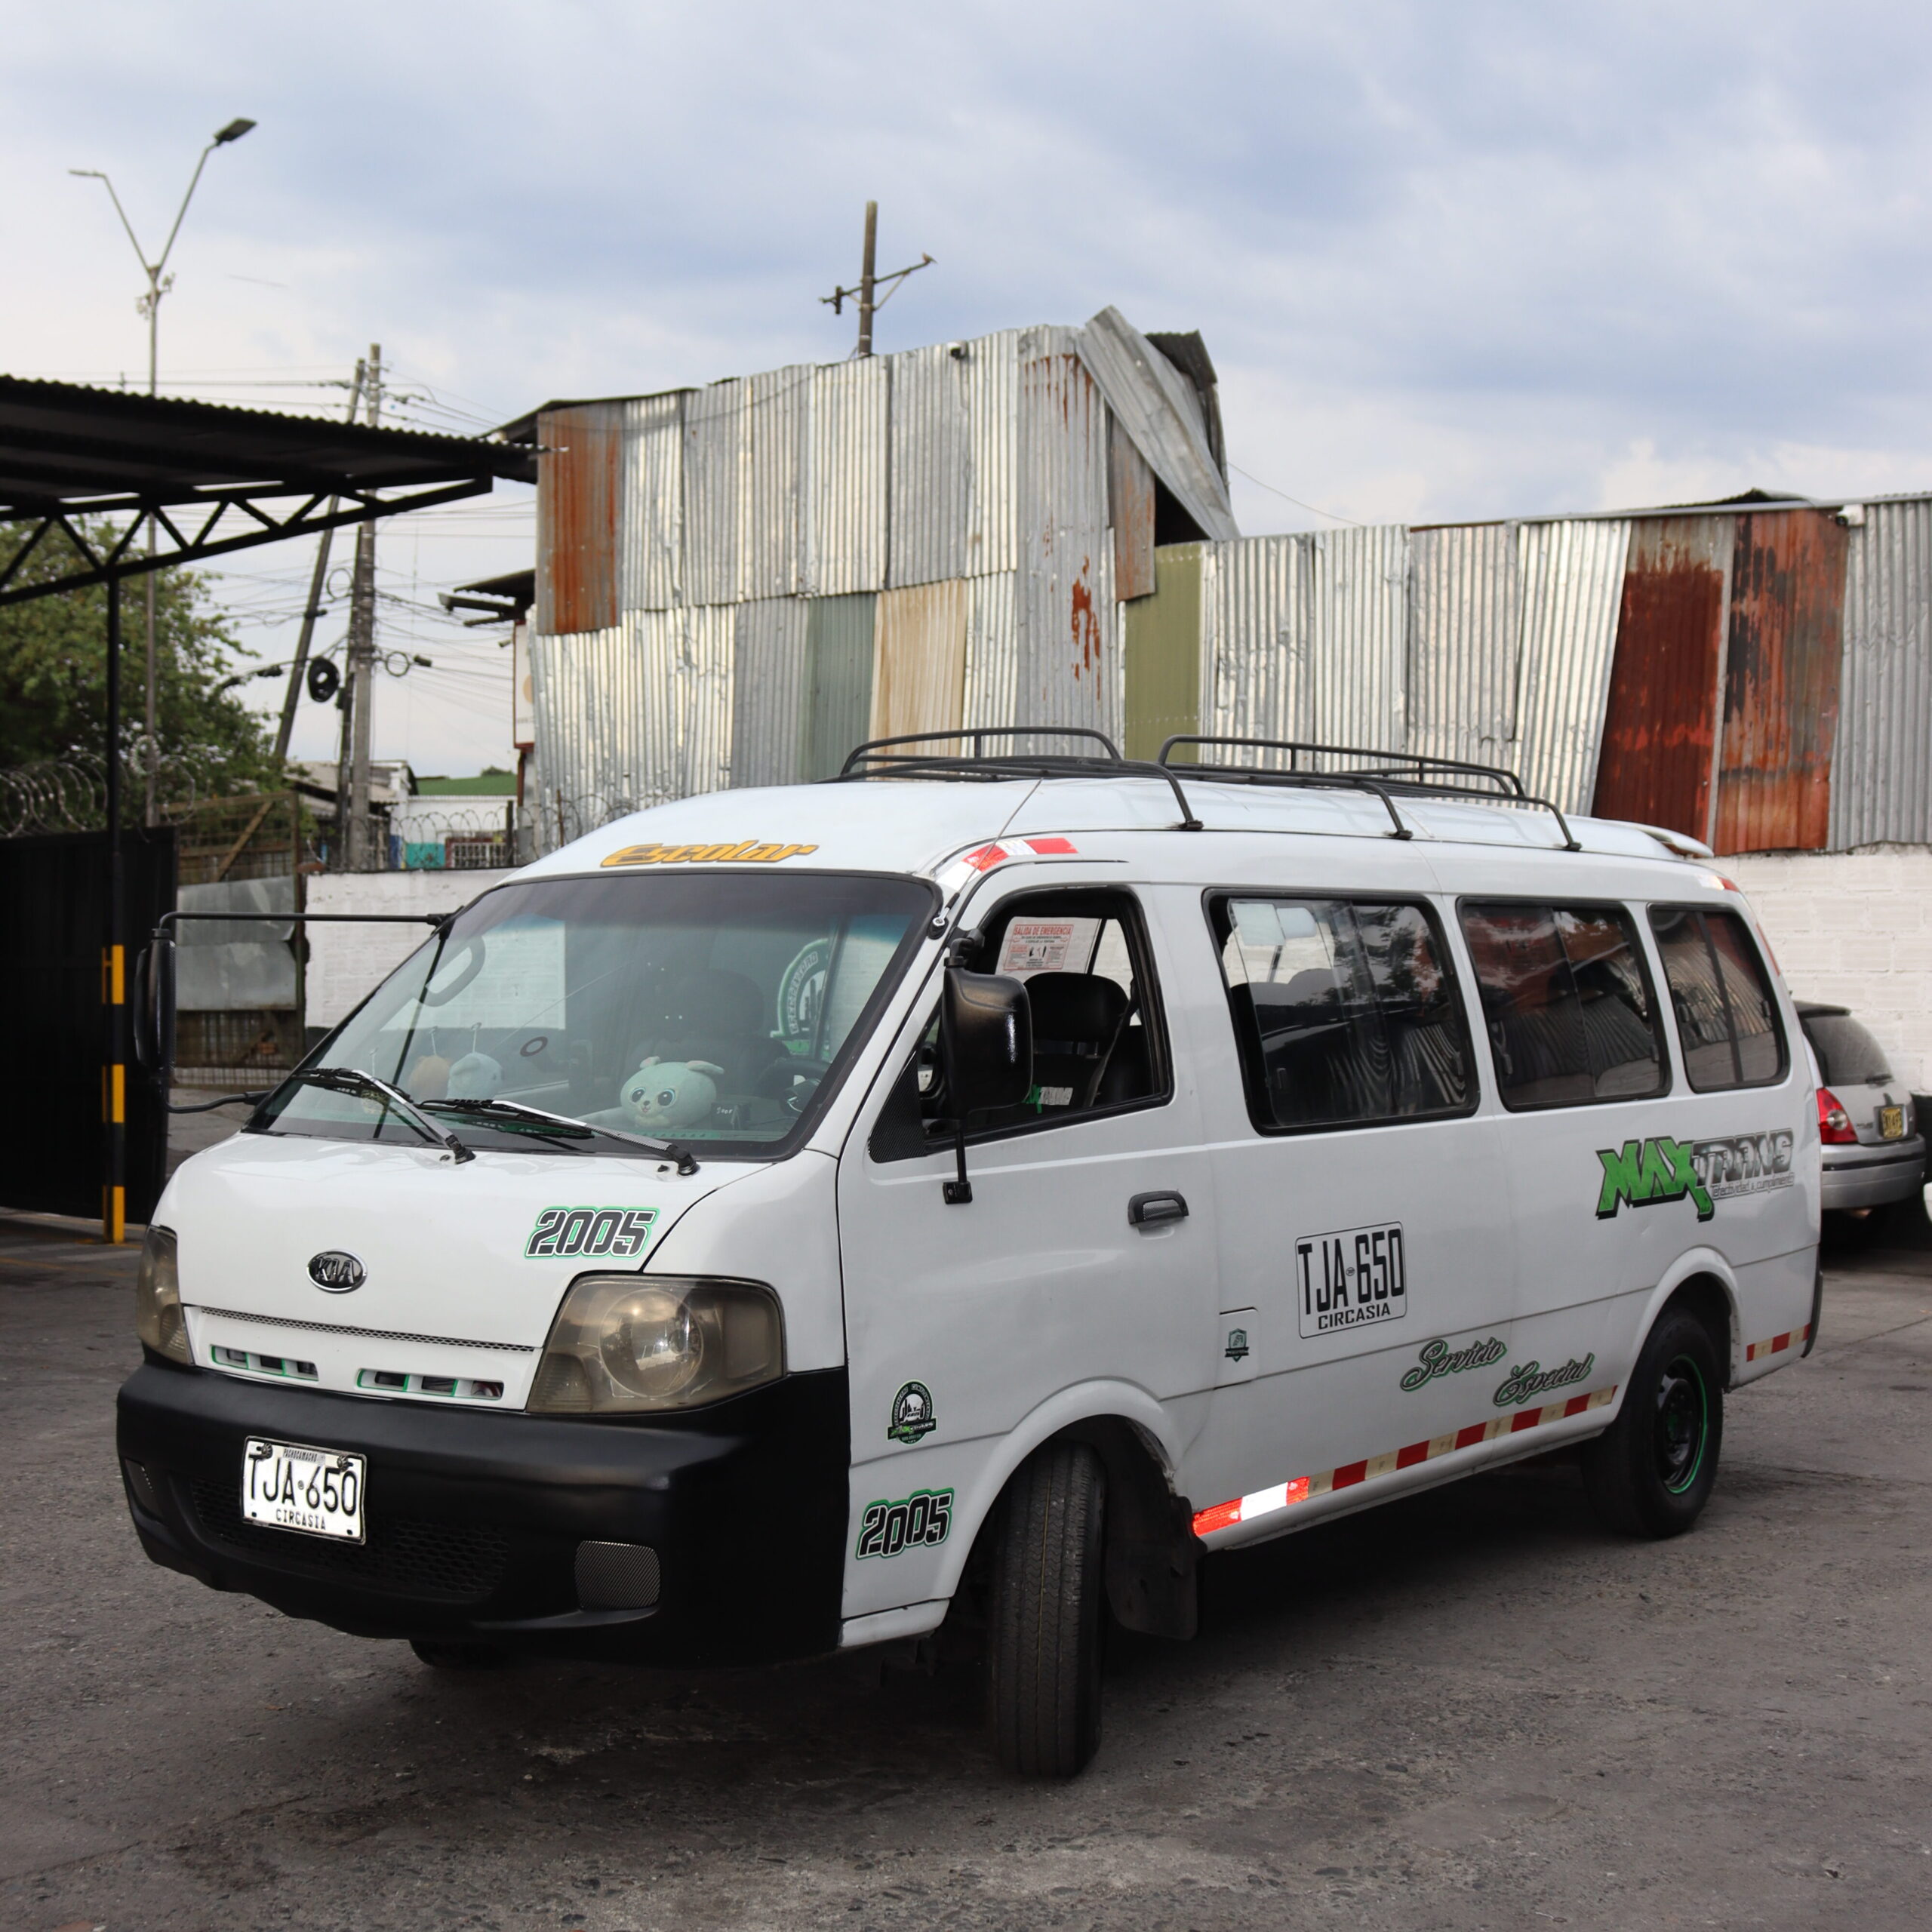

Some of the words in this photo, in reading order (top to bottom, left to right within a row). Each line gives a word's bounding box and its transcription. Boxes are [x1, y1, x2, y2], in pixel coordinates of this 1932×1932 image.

[600, 839, 819, 867] Escolar
[1014, 926, 1032, 935] SALIDA
[1032, 926, 1041, 935] DE
[1040, 926, 1072, 935] EMERGENCIA
[526, 1208, 658, 1258] 2005
[315, 1257, 355, 1284] KIA
[1318, 1302, 1391, 1331] CIRCASIA
[1400, 1337, 1506, 1391] Servicio
[1493, 1353, 1595, 1406] Especial
[275, 1509, 326, 1531] CIRCASIA
[857, 1491, 953, 1559] 2005
